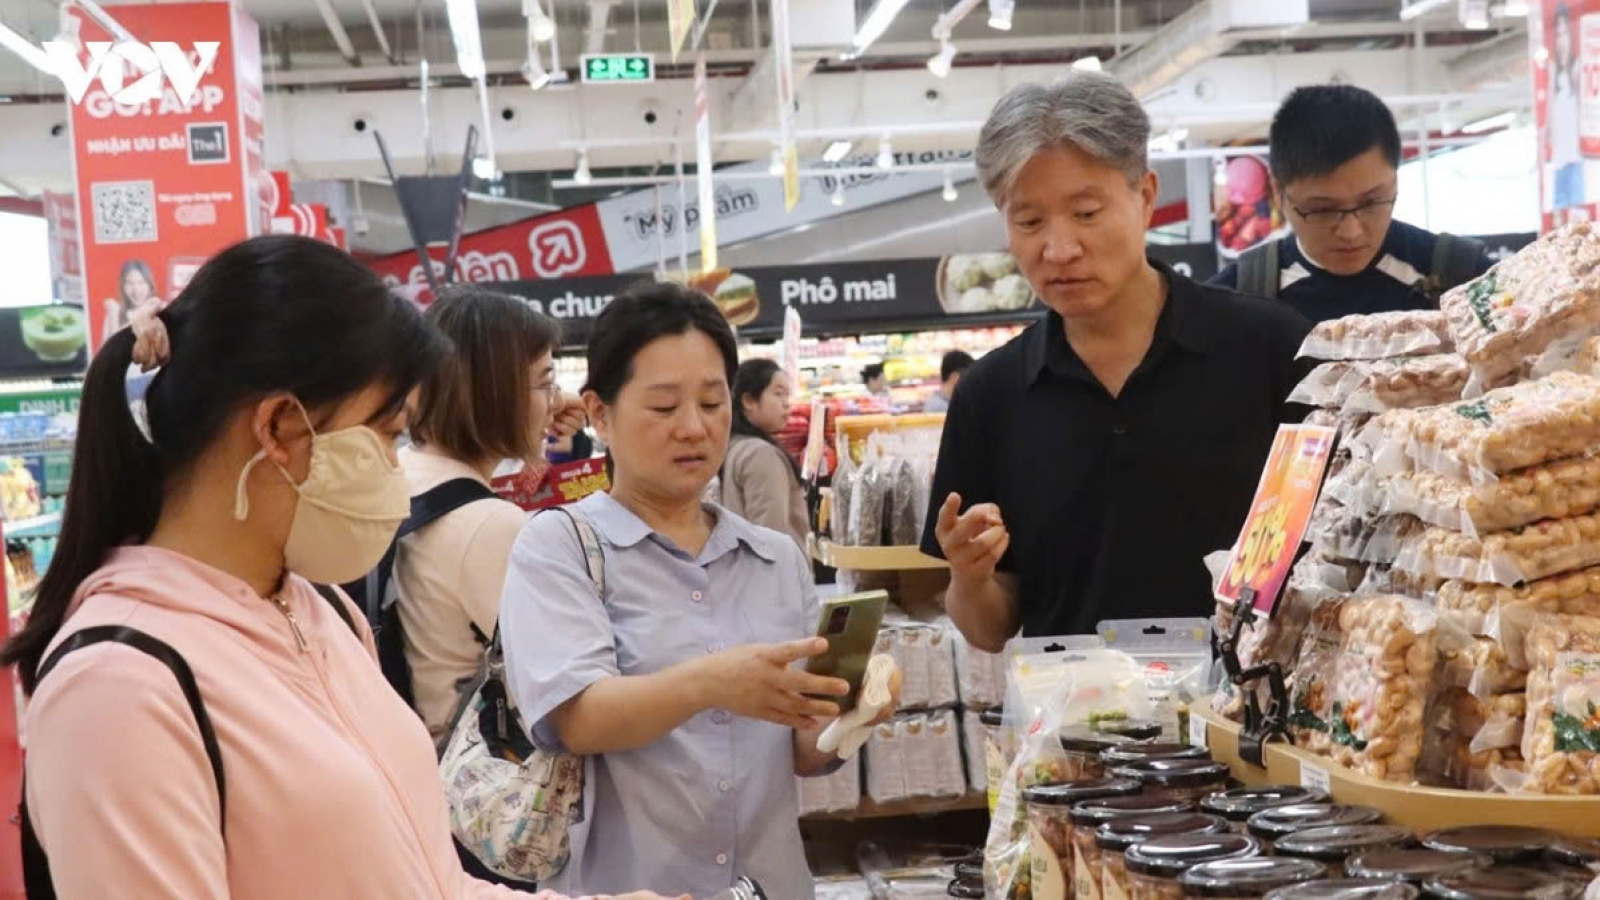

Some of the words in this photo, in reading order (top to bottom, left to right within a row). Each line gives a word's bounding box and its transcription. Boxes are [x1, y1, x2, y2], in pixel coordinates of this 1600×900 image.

[158, 84, 223, 115] APP
[781, 276, 837, 305] Phô
[844, 272, 896, 302] mai
[549, 291, 615, 318] chu
